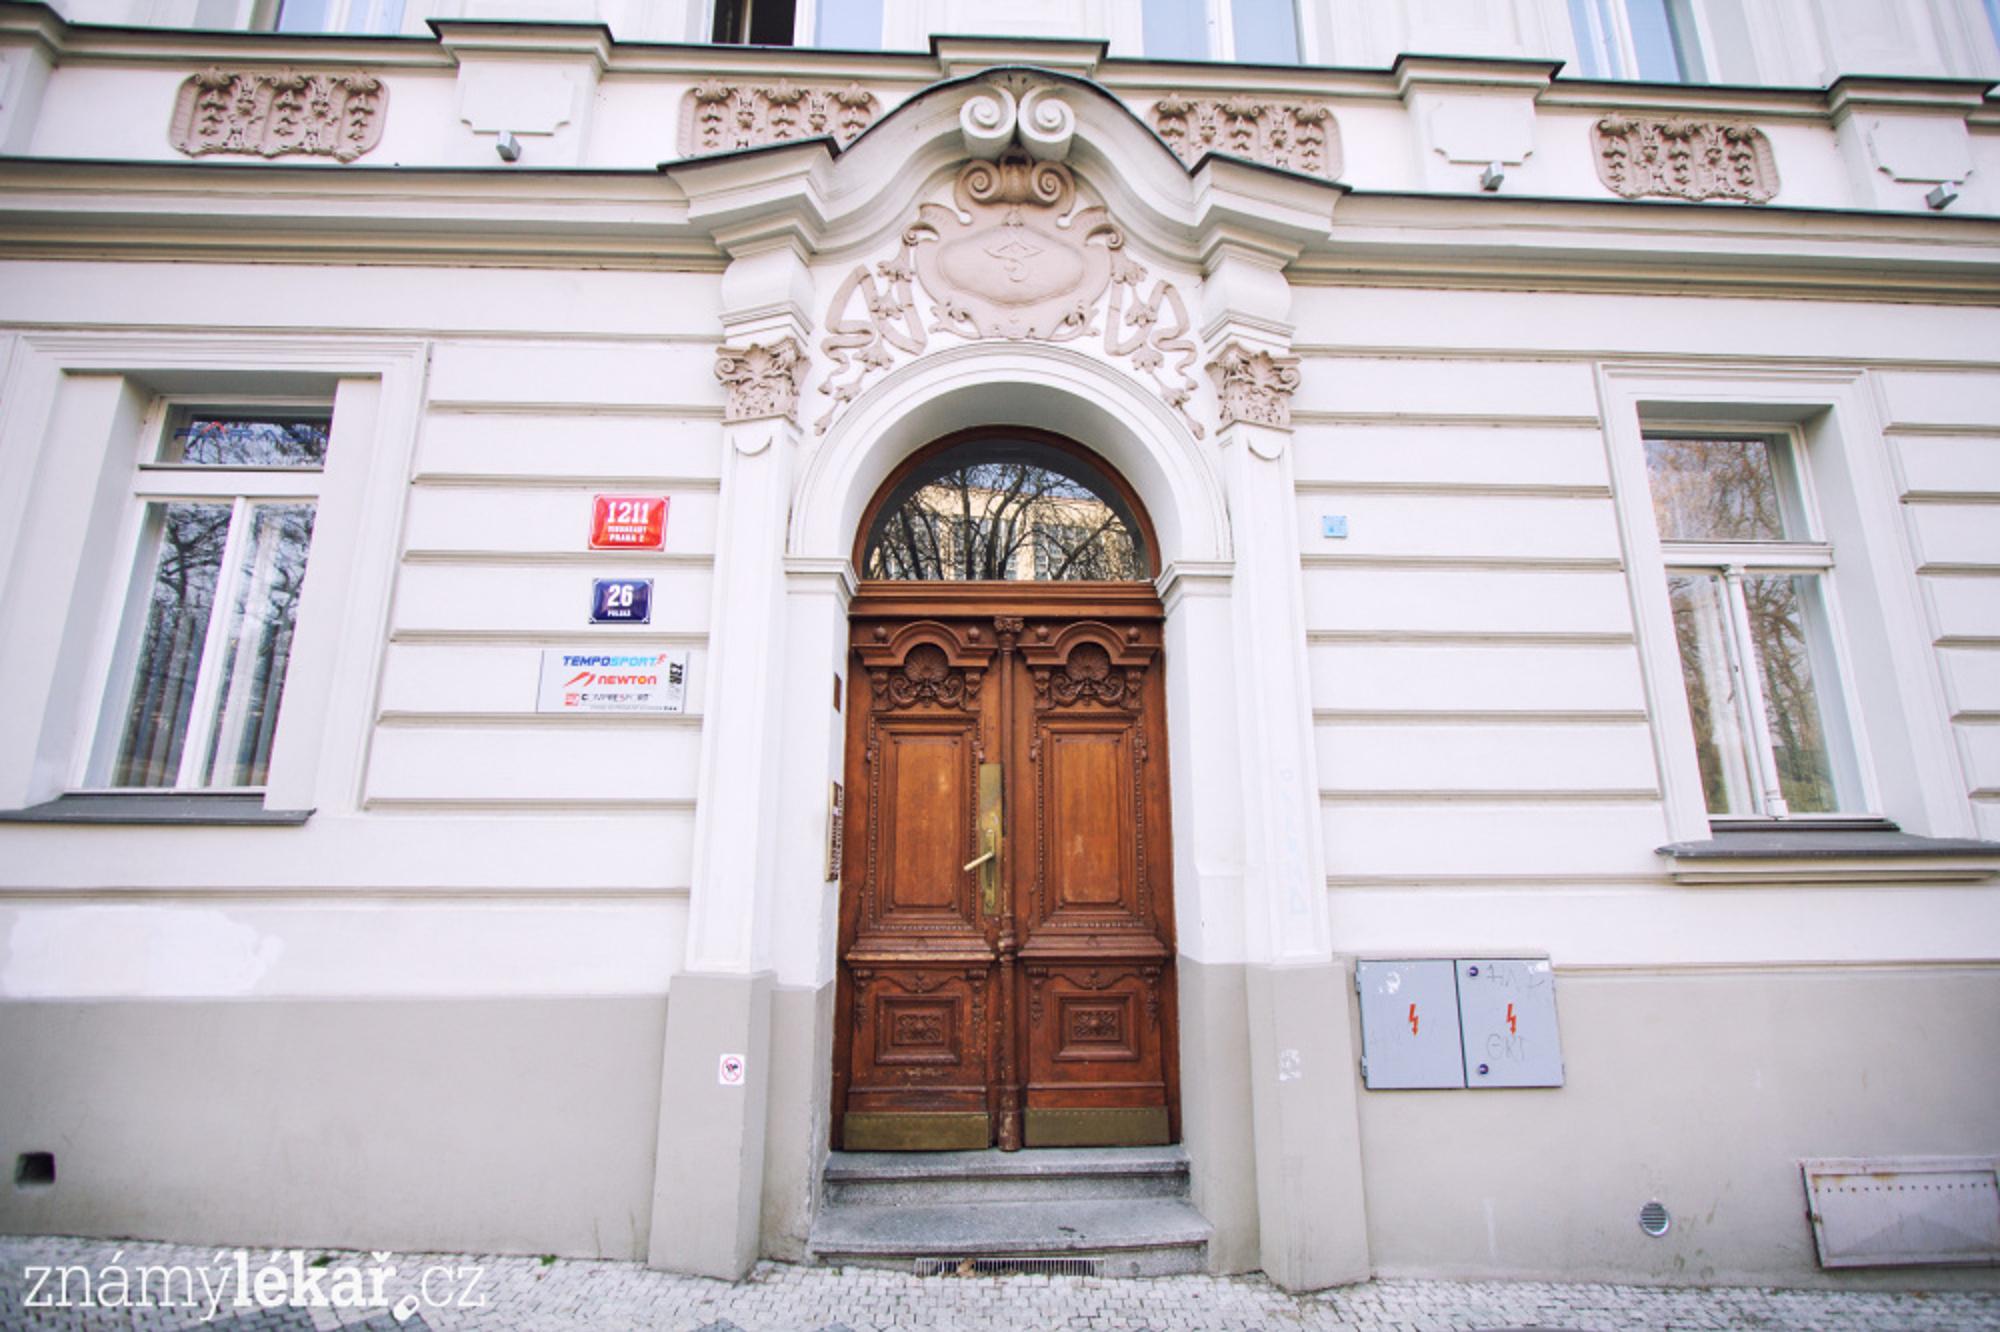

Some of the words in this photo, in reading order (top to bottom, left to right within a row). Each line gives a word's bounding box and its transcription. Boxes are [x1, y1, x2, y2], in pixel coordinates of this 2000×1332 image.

[607, 502, 649, 524] 1211
[609, 533, 637, 542] PRAHA
[607, 584, 634, 607] 26
[562, 655, 657, 667] TEMPOSPORT
[598, 675, 657, 685] NEWTON
